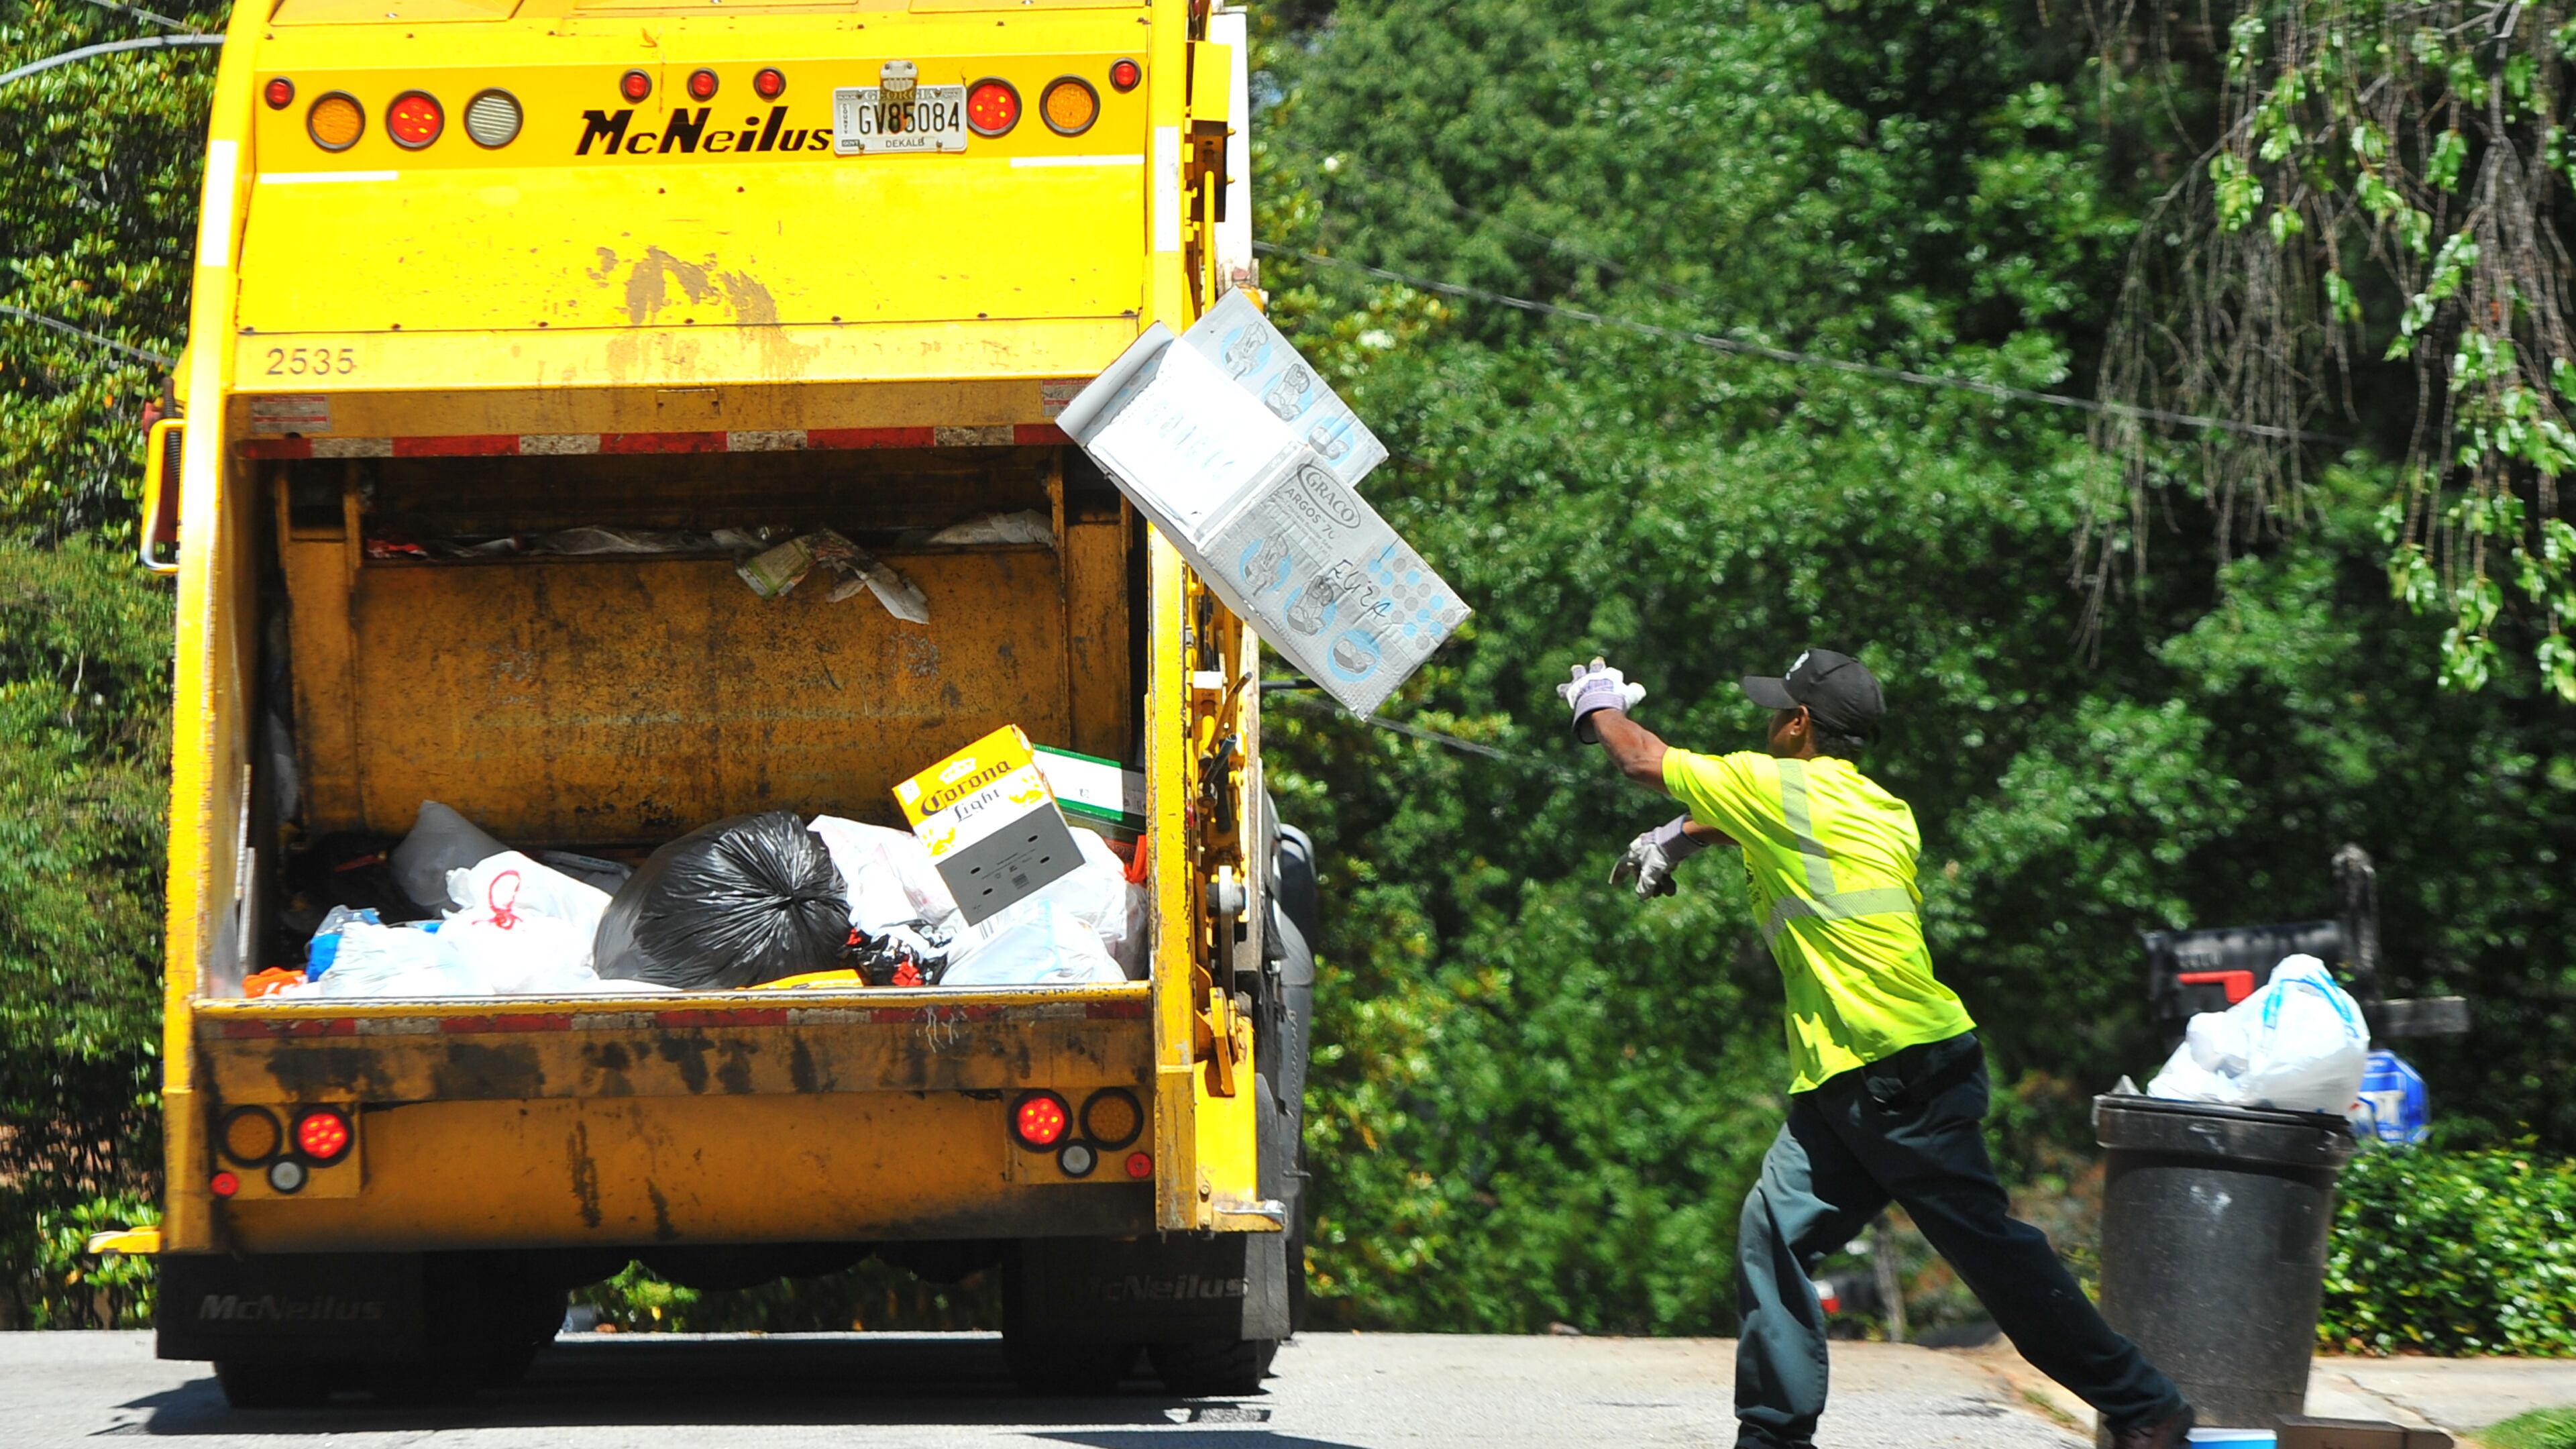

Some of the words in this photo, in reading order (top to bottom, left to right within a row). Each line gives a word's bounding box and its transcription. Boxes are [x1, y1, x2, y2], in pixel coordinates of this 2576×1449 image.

[864, 89, 936, 101] GEORGIA
[574, 106, 833, 155] McNeilus
[859, 101, 960, 135] GV85084
[885, 138, 925, 148] DEKALB
[266, 347, 354, 375] 2535
[1285, 488, 1322, 523] ARGOS
[1305, 471, 1355, 522] GRACO
[921, 761, 1012, 816] Corona
[954, 789, 1000, 823] Light
[199, 1295, 385, 1320] McNeilus
